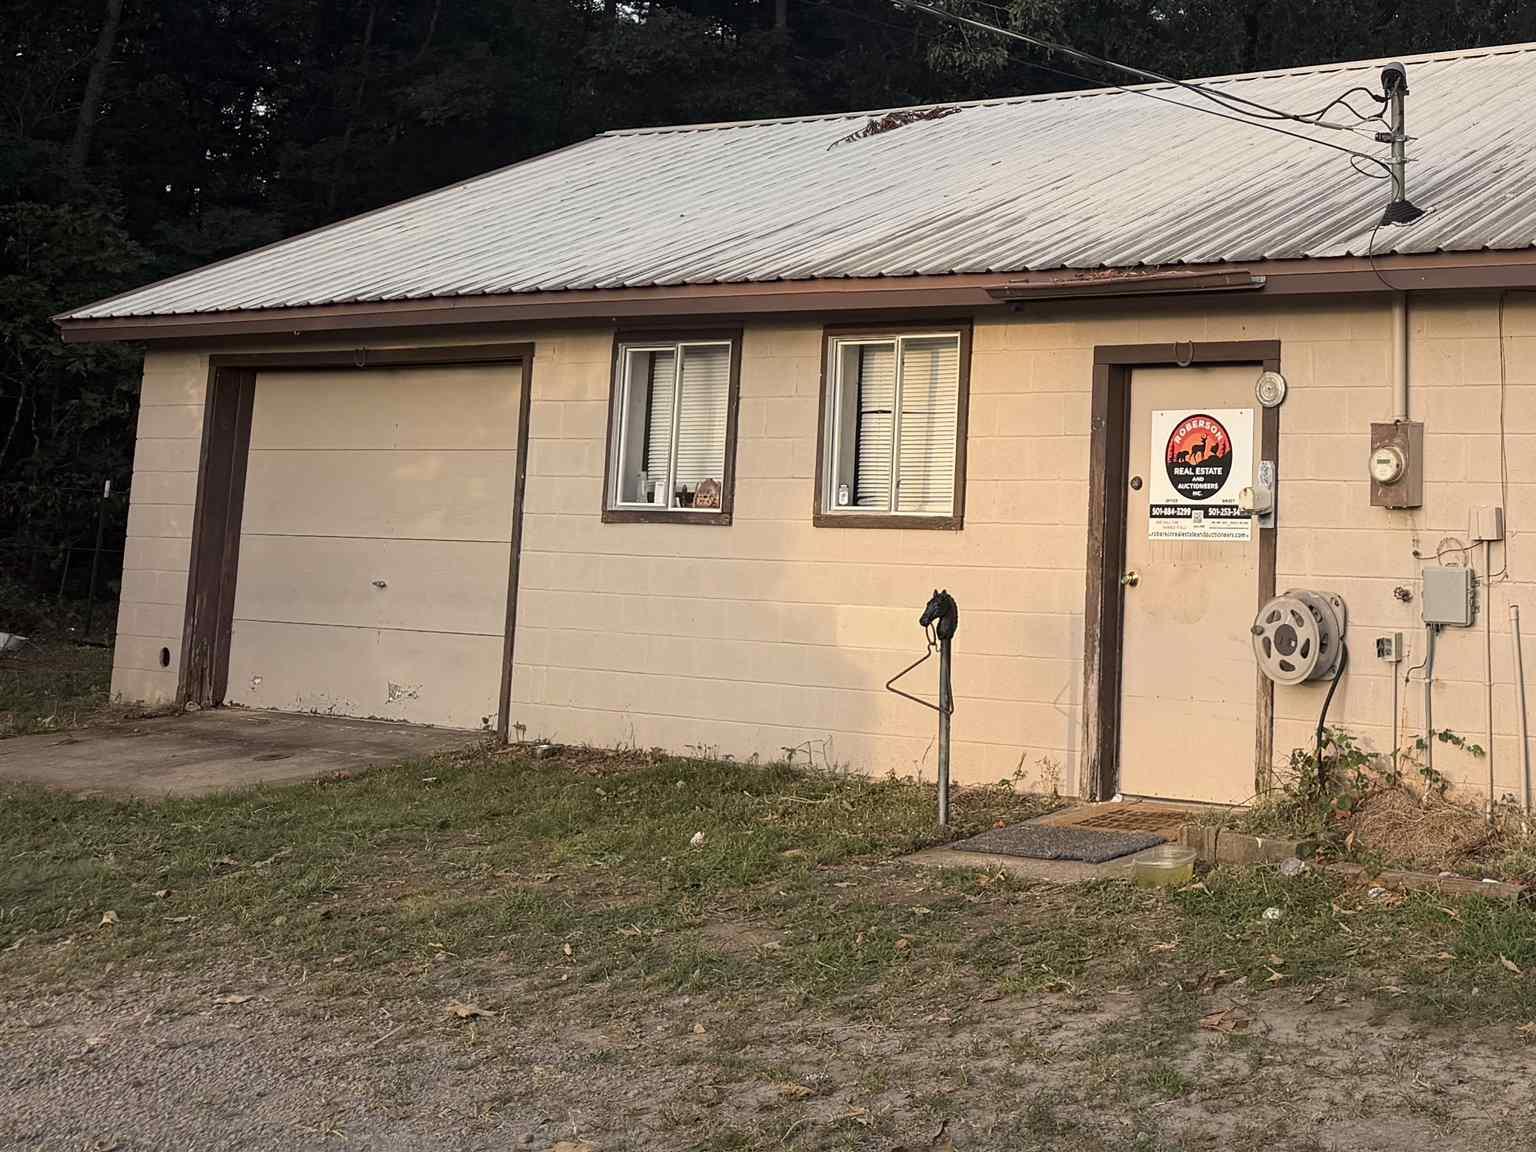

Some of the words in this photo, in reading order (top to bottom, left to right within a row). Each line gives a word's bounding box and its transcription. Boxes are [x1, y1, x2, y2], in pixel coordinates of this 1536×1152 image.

[1174, 420, 1224, 444] ROBERSON
[1174, 467, 1194, 475] REAL
[1196, 467, 1222, 475] ESTATE
